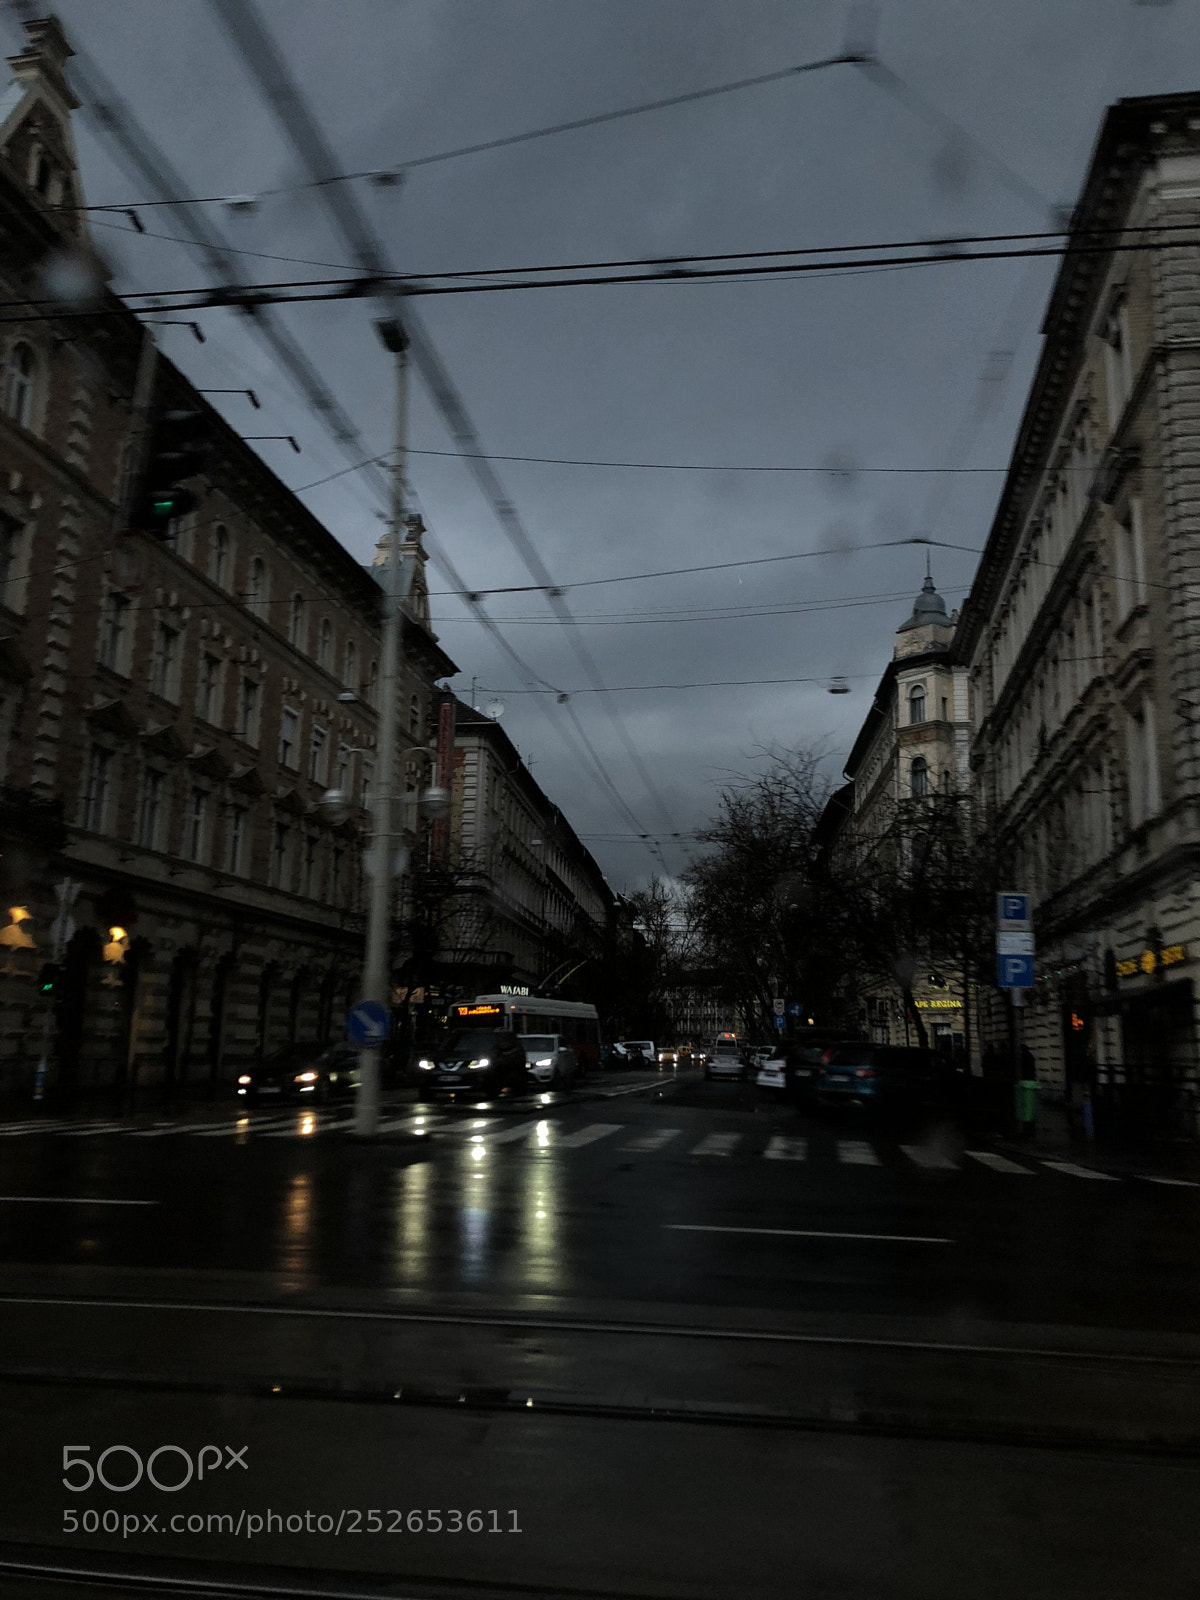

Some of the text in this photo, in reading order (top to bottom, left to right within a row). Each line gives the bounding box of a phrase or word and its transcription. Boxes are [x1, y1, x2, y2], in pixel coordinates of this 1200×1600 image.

[1006, 898, 1024, 917] P
[1005, 958, 1027, 983] P
[930, 1000, 962, 1008] REGINA
